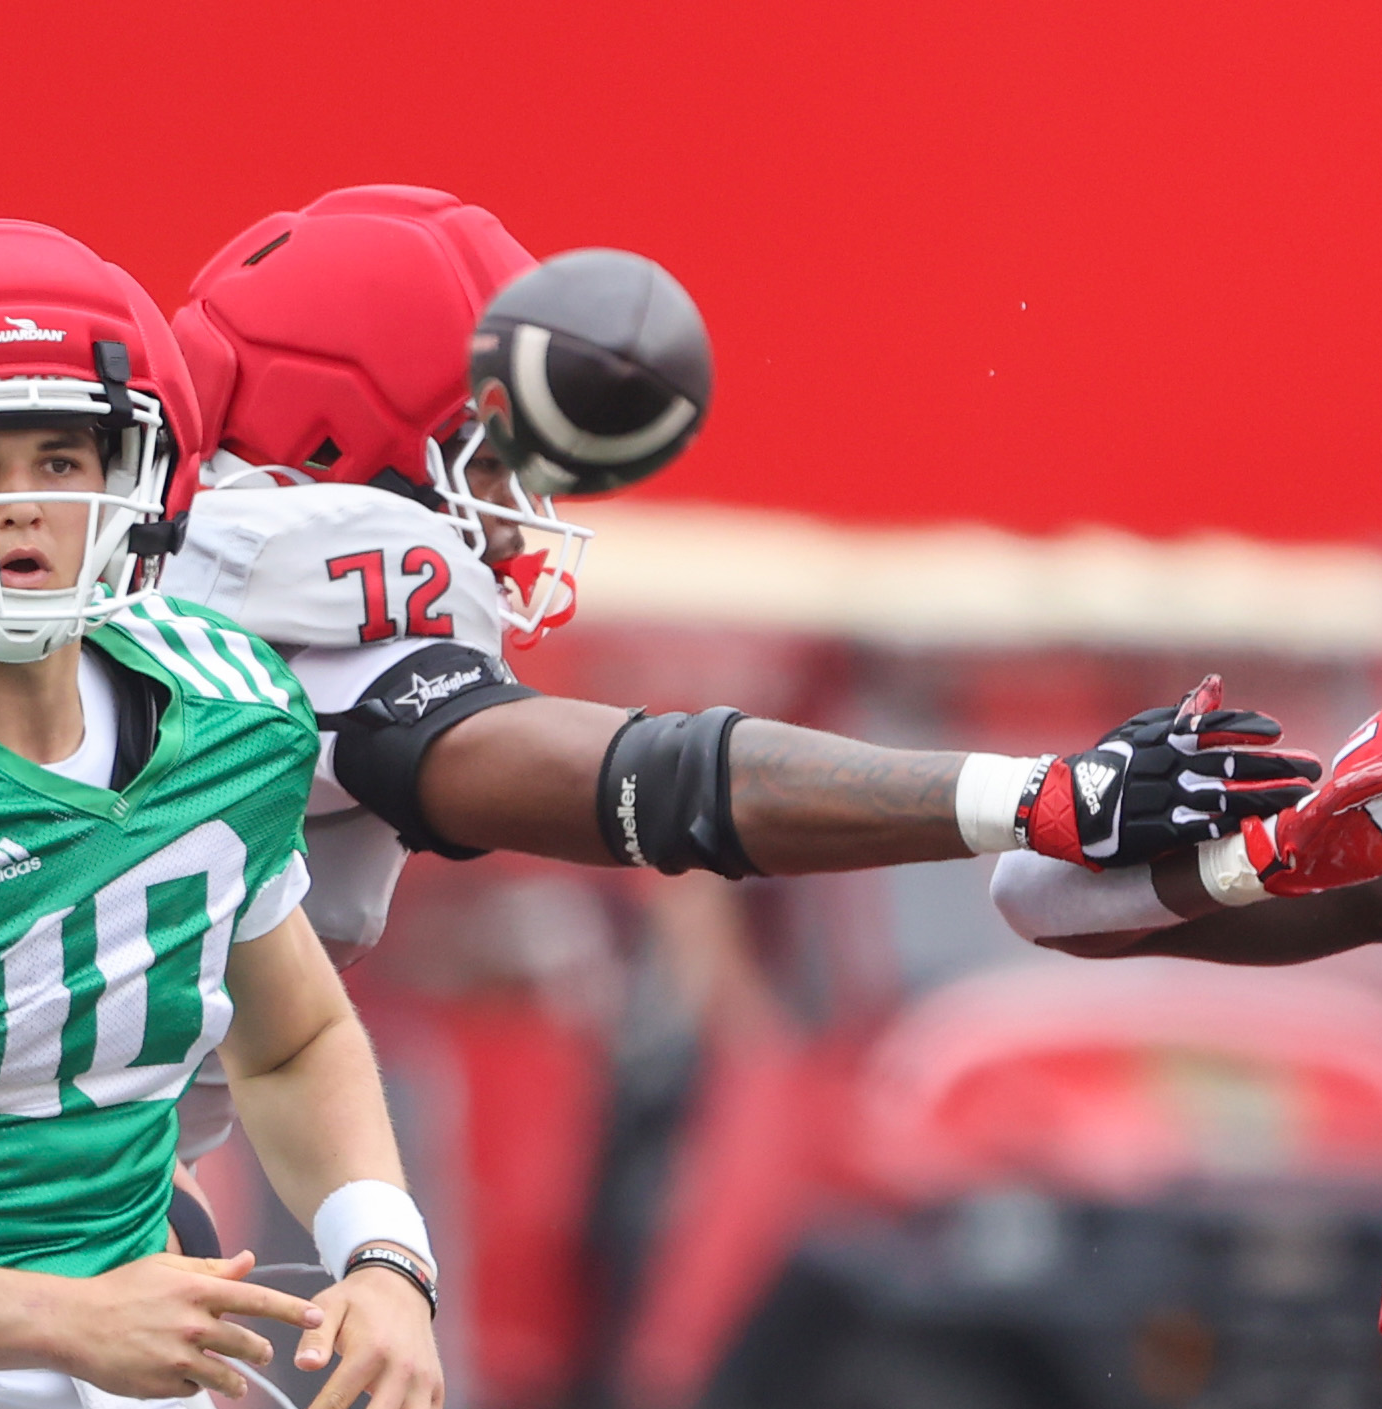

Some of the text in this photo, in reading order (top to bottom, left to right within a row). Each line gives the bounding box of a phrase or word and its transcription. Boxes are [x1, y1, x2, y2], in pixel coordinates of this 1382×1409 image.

[326, 546, 454, 643] 72
[1075, 760, 1102, 815] adidas
[362, 1248, 413, 1271] TRUST
